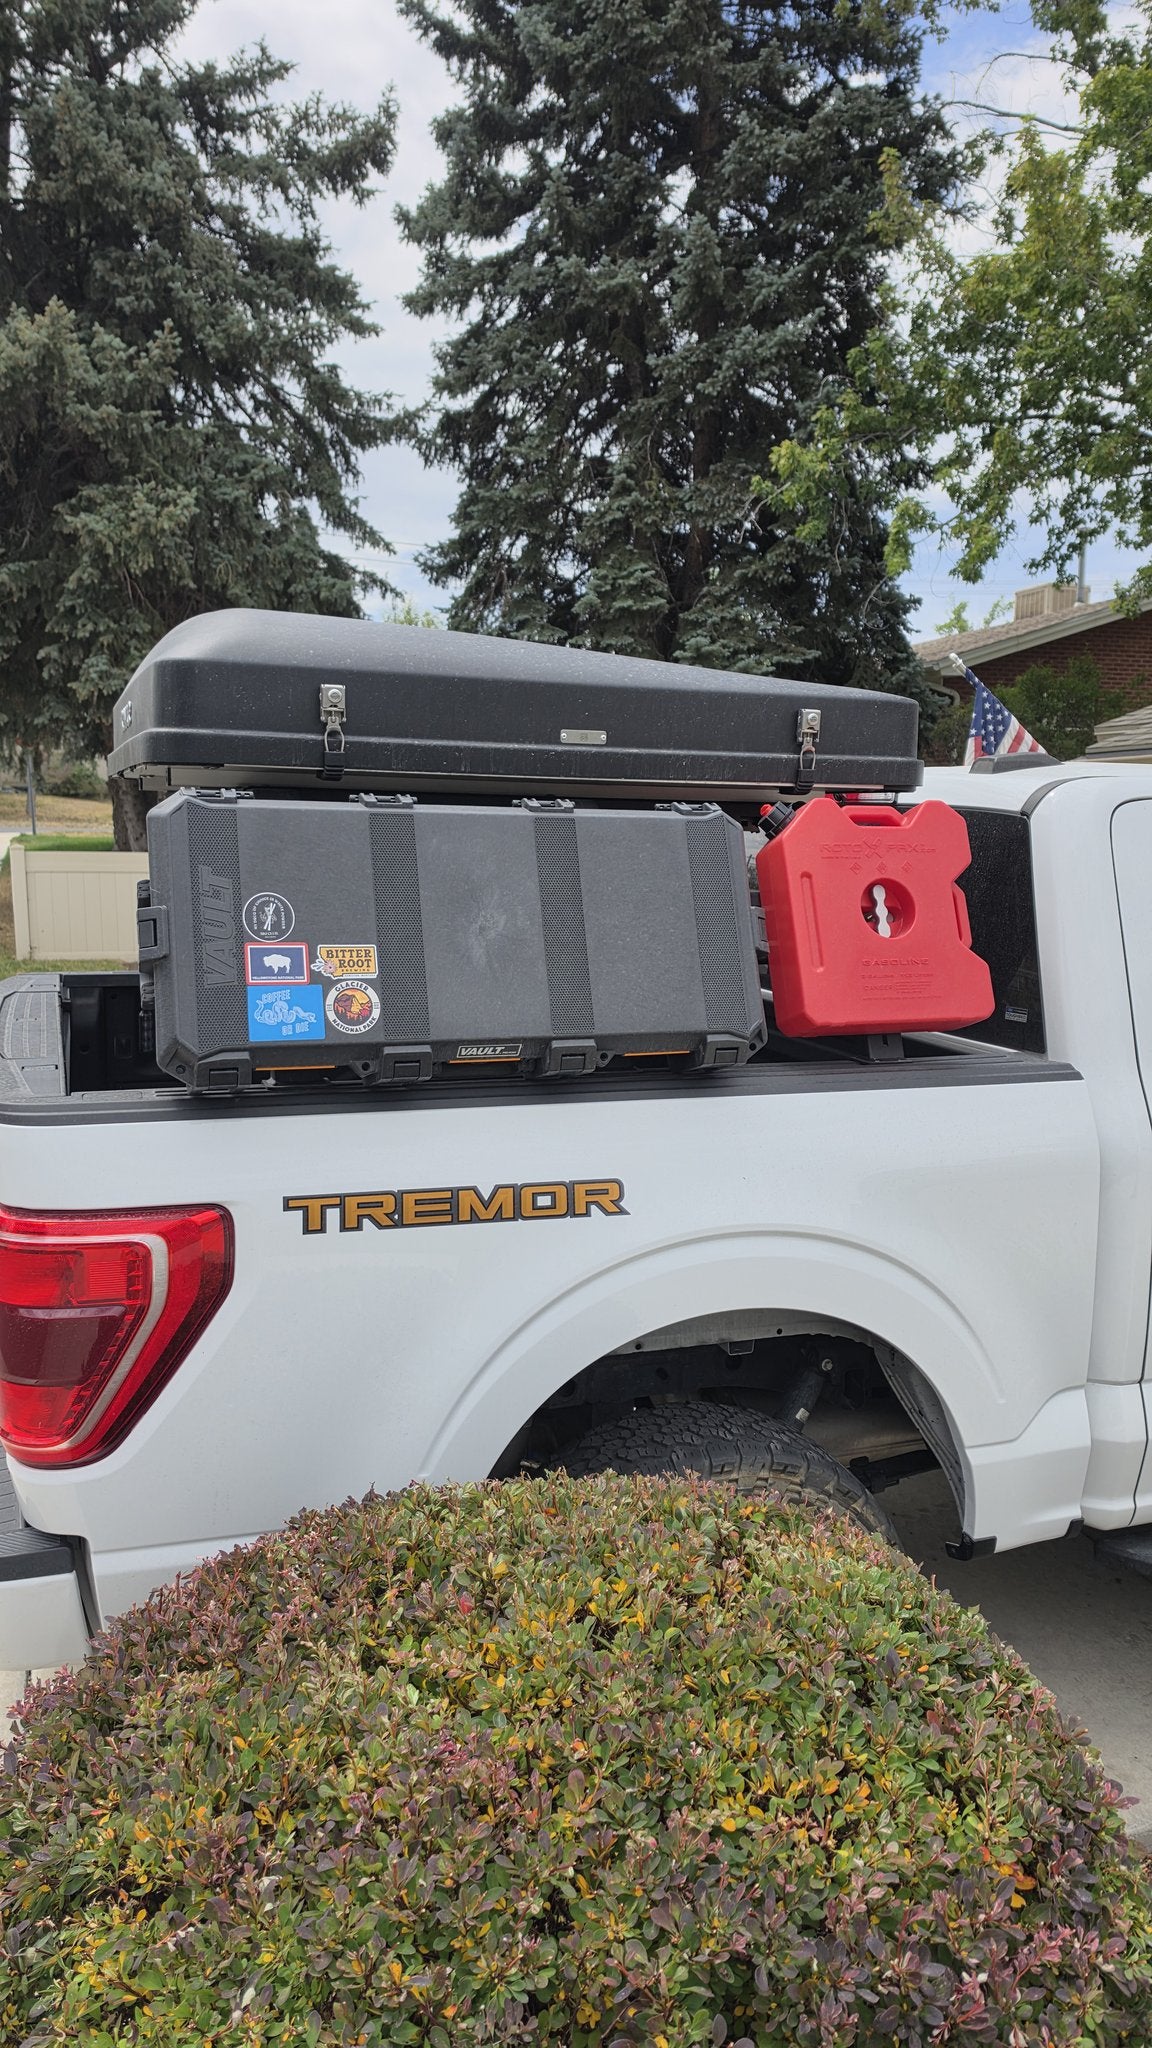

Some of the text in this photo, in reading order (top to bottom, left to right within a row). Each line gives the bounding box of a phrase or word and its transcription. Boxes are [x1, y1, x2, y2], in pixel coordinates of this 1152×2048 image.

[201, 864, 235, 986] VAULT
[326, 949, 372, 959] BITTER
[338, 959, 372, 969] ROOT
[862, 957, 929, 967] GASOLINE
[335, 981, 369, 992] GLACIER
[261, 989, 291, 1004] COFFEE
[332, 1016, 377, 1033] NATIONAL PARK
[461, 1046, 505, 1056] VAULT
[283, 1178, 631, 1235] TREMOR
